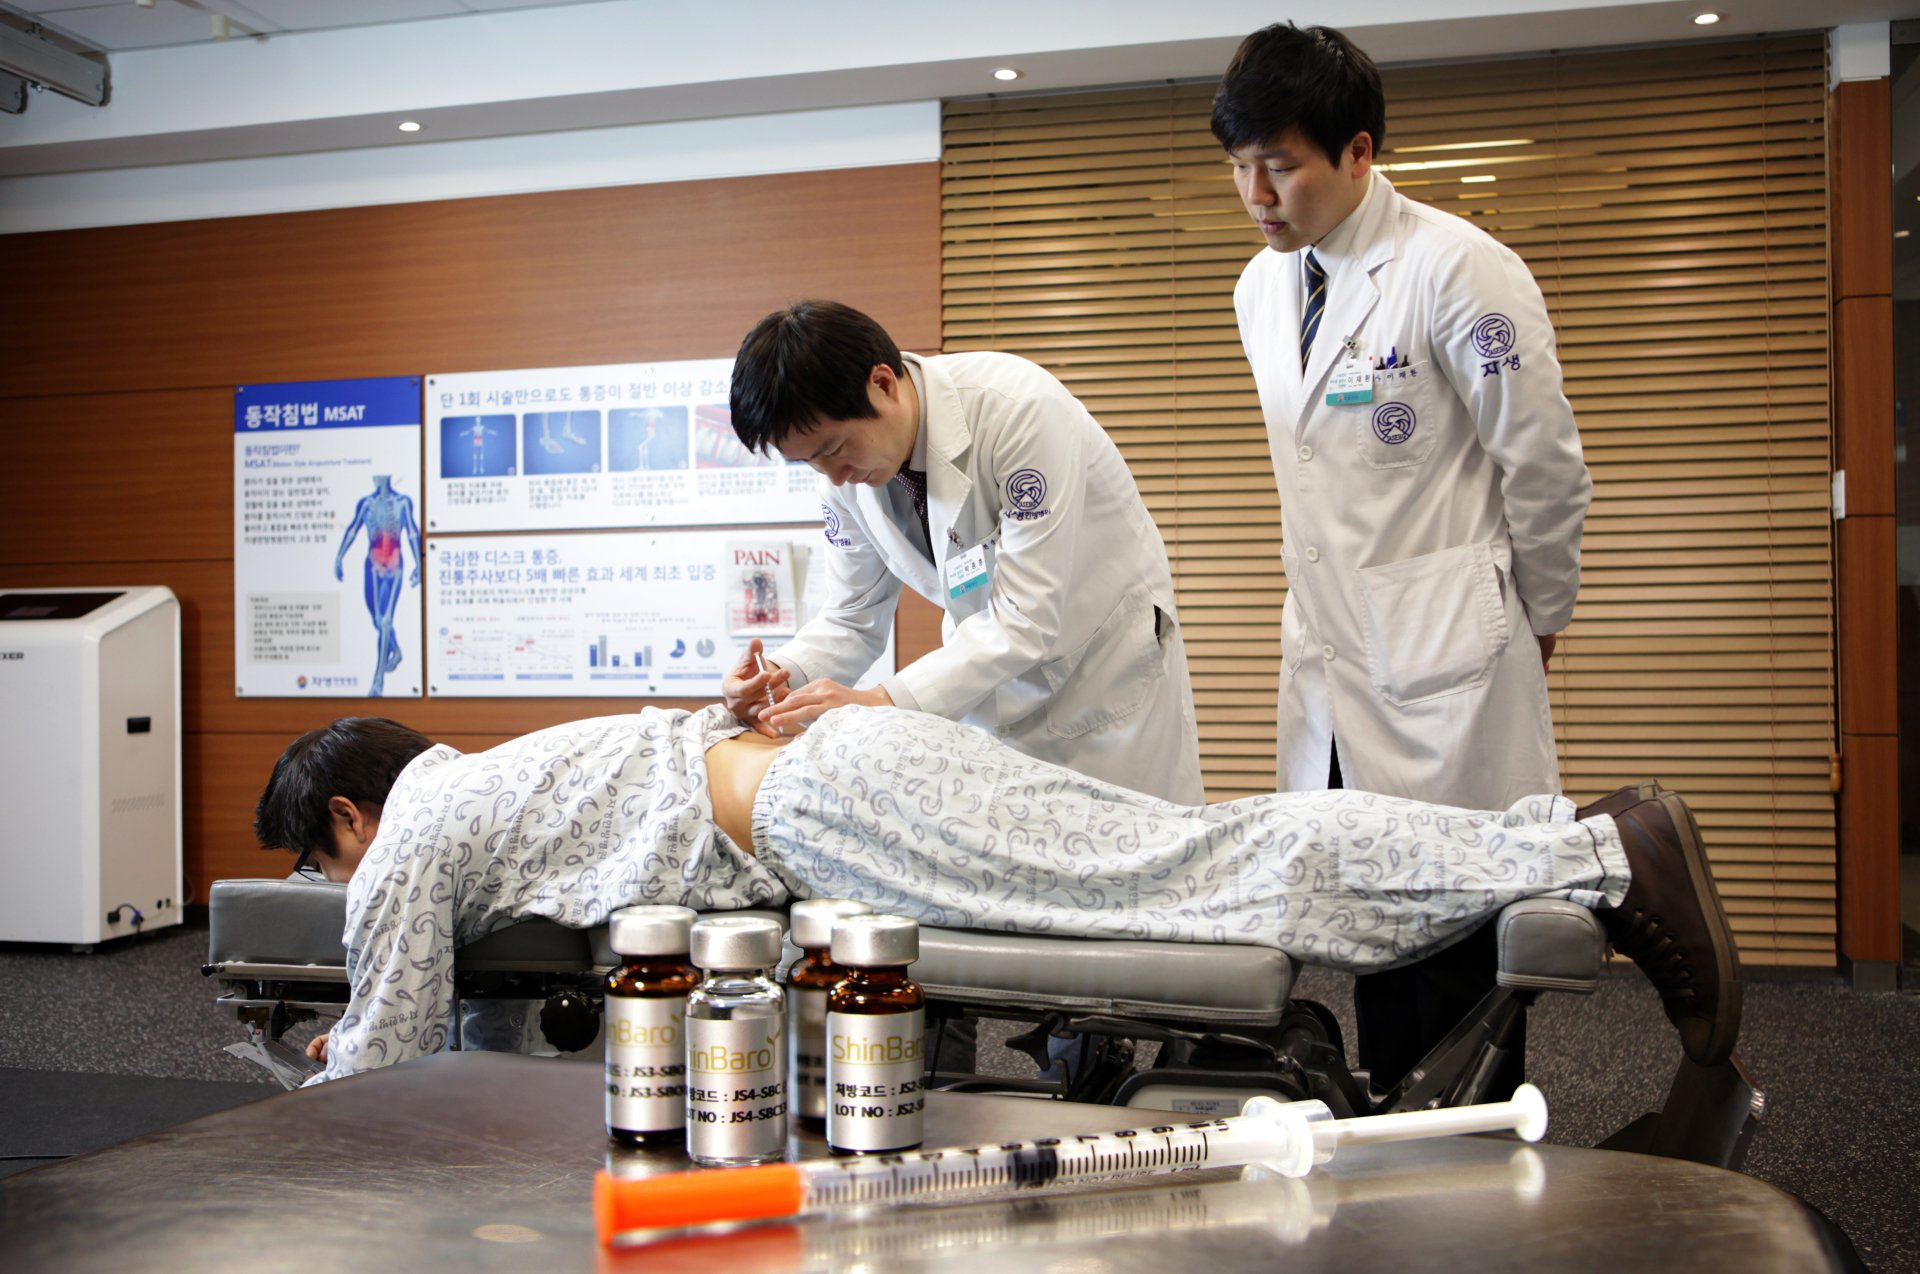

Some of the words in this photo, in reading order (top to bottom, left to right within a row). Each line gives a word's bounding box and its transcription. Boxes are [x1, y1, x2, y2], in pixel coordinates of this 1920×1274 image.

[440, 392, 452, 409] 단
[459, 391, 481, 407] 1회
[486, 387, 573, 406] 시술만으로도
[578, 384, 622, 402] 통증이
[628, 382, 657, 400] 절반
[663, 380, 692, 397] 이상
[699, 379, 729, 396] 감소
[244, 402, 319, 429] 동작침법
[324, 404, 366, 422] MSAT
[439, 551, 480, 567] 극심한
[484, 549, 526, 566] 디스크
[734, 549, 781, 566] PAIN
[439, 568, 521, 586] 진통주사보다
[526, 567, 548, 584] 5배
[552, 565, 580, 584] 빠른
[586, 566, 614, 583] 효과
[619, 564, 648, 582] 세계
[653, 563, 682, 581] 최초
[687, 563, 717, 581] 입증
[608, 1020, 675, 1044] nBaro
[732, 1084, 781, 1102] JS4-SBC
[835, 1082, 887, 1097] 처방코드
[698, 1111, 717, 1123] NO
[835, 1104, 857, 1117] LOT
[861, 1106, 884, 1118] NO
